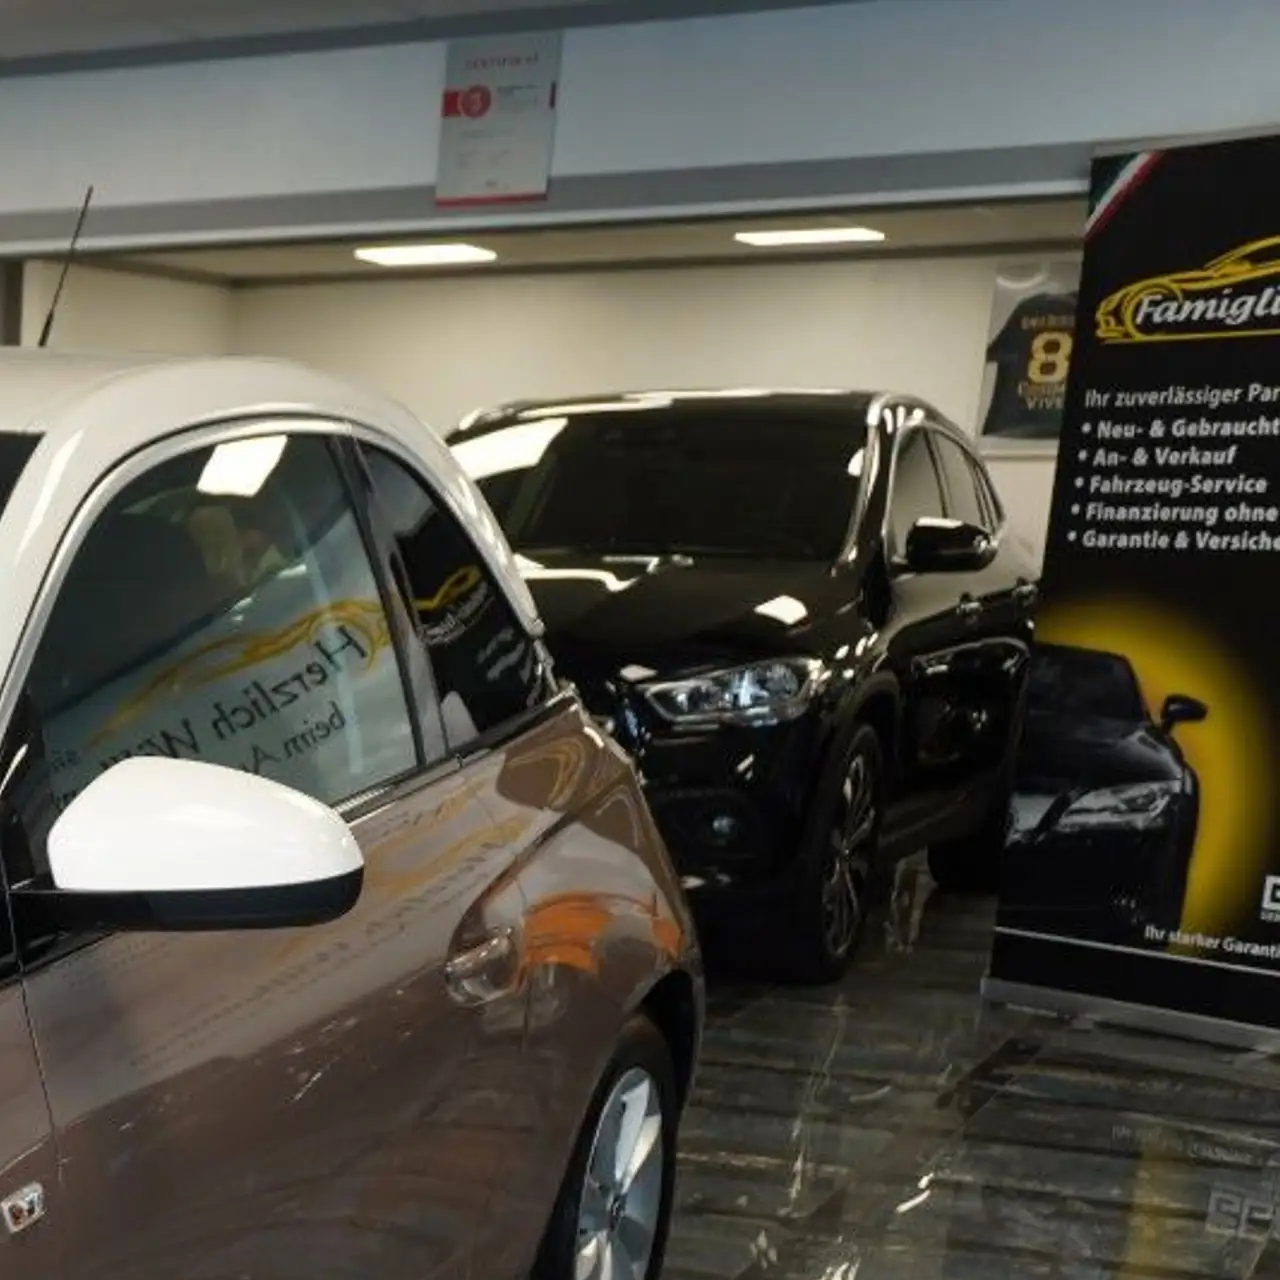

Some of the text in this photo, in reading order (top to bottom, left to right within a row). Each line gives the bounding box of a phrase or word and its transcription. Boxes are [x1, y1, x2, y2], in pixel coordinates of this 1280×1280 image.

[1028, 331, 1073, 383] 8
[1085, 389, 1110, 408] Ihr
[1114, 384, 1242, 410] zuverlässiger
[1097, 415, 1280, 440] Neu- & Gebraucht
[1092, 444, 1238, 467] An- & Verkauf
[1089, 473, 1268, 498] Fahrzeug-Service
[1085, 502, 1280, 526] Finanzierung ohne
[1082, 529, 1170, 549] Garantie
[1174, 530, 1190, 548] &
[1145, 925, 1166, 940] Ihr
[1168, 930, 1220, 949] starker
